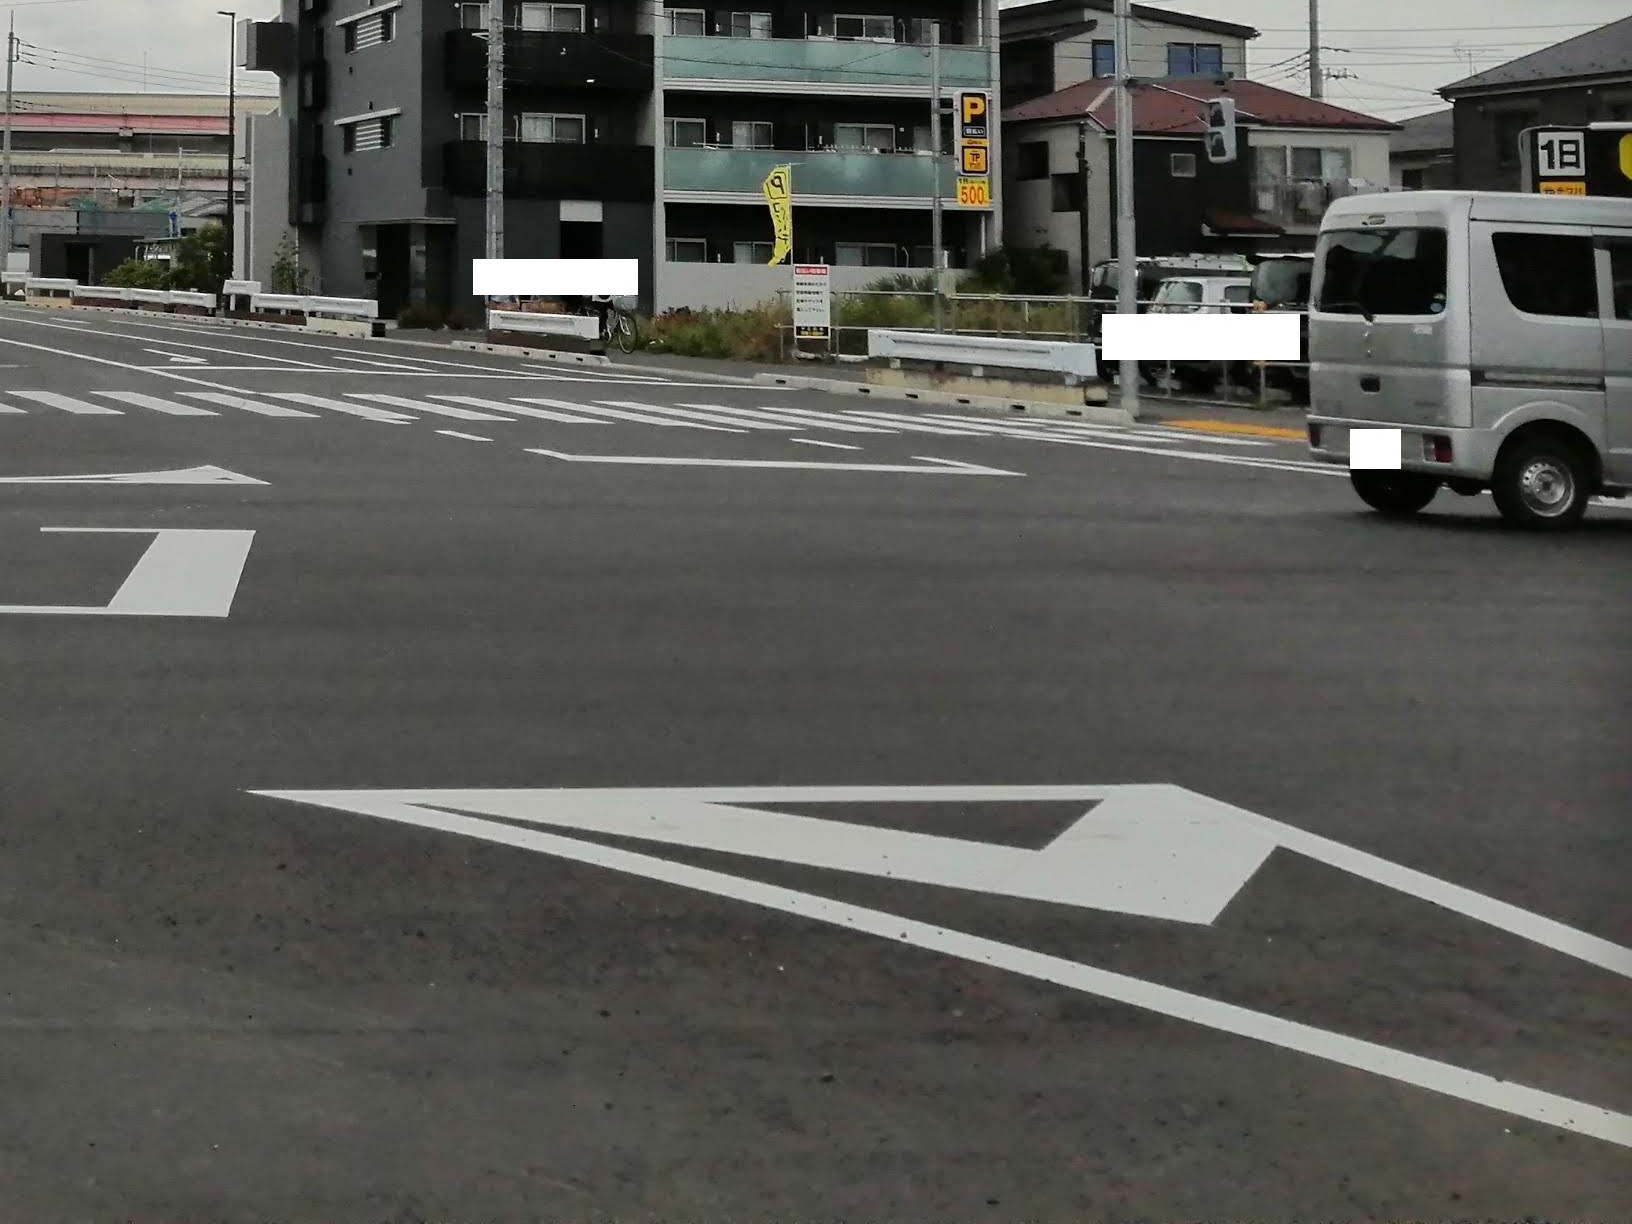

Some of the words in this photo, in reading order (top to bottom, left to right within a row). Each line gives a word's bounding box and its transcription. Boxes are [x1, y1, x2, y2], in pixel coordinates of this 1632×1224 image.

[963, 96, 985, 124] P
[1540, 139, 1581, 170] 1日
[961, 185, 985, 205] 500
